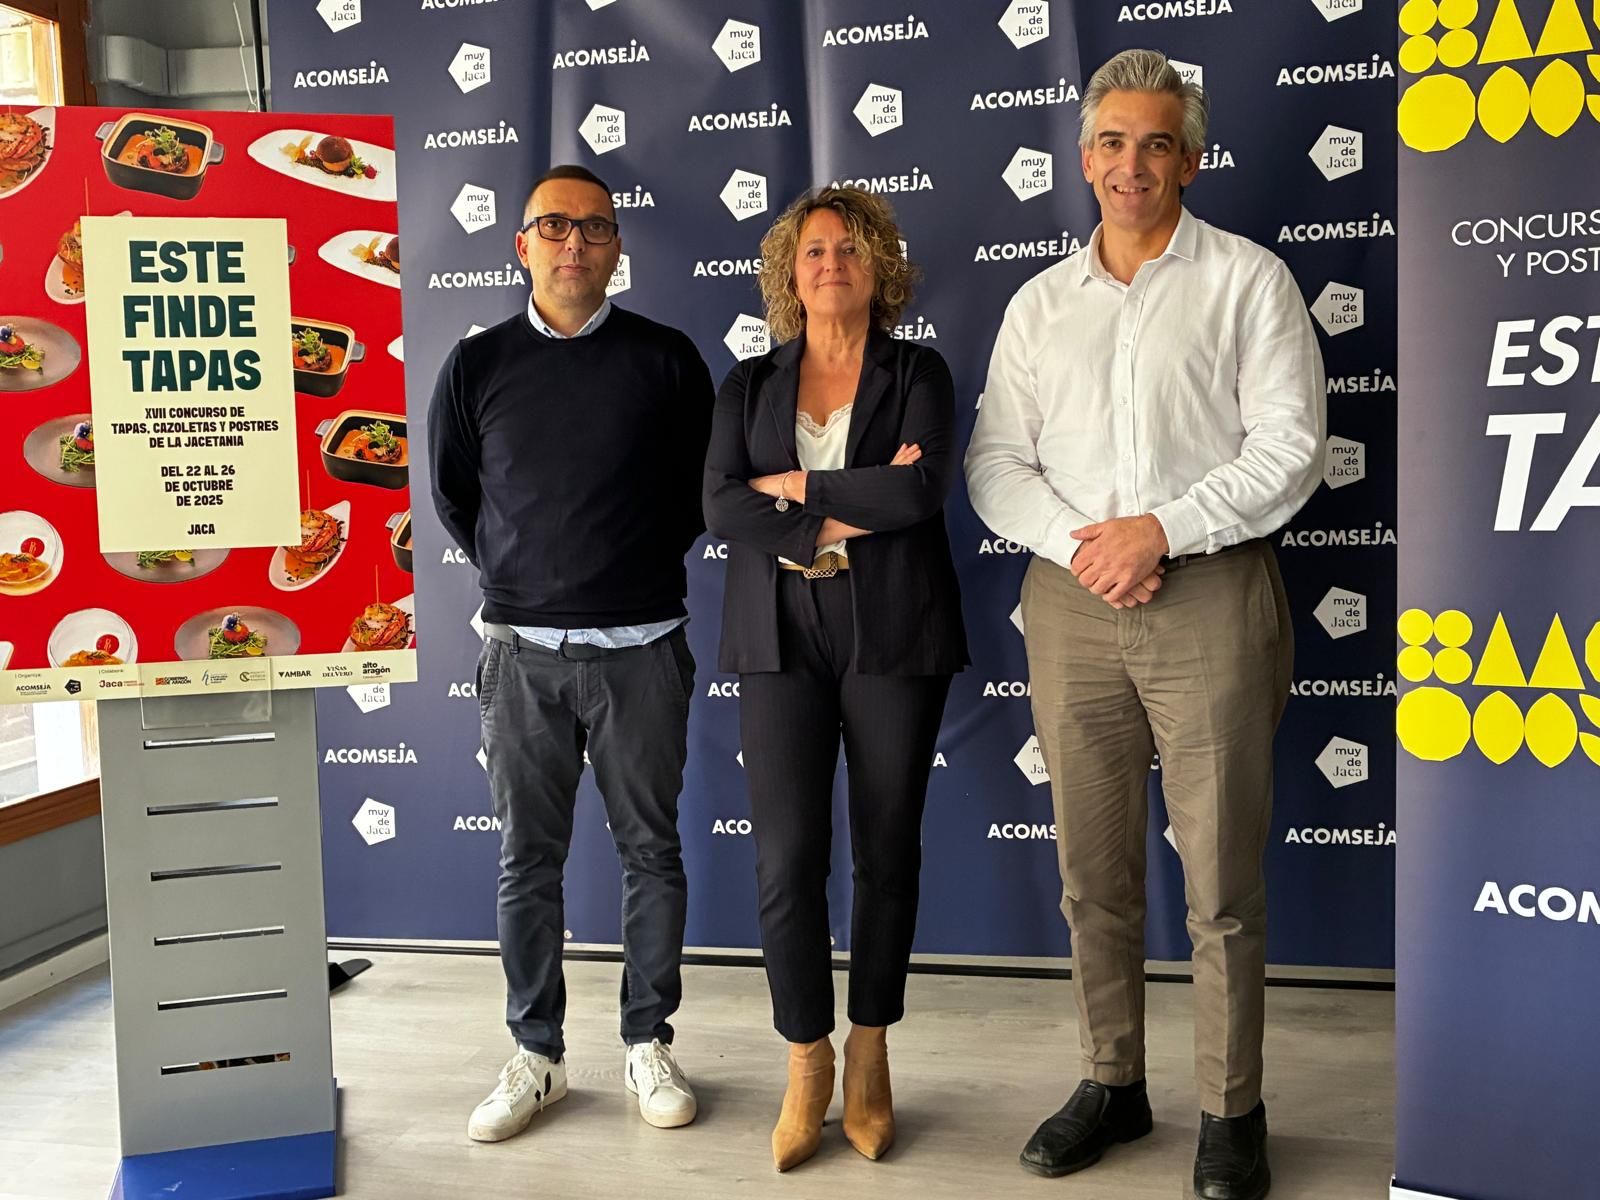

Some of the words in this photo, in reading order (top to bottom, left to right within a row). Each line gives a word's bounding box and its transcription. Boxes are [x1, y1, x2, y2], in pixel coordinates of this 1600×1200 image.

[1018, 5, 1042, 14] muy
[1118, 0, 1232, 21] ACOMSEJA
[332, 11, 356, 21] Jaca
[1029, 16, 1042, 24] de
[730, 30, 753, 39] muy
[823, 15, 928, 47] ACOMSEJA
[1016, 24, 1043, 36] Jaca
[741, 40, 754, 48] de
[465, 53, 484, 63] muy
[553, 40, 649, 69] ACOMSEJA
[728, 50, 754, 60] Jaca
[473, 62, 485, 70] de
[1276, 54, 1394, 85] ACOMSEJA
[294, 61, 389, 88] ACOMSEJA
[462, 71, 486, 82] Jaca
[1177, 70, 1196, 79] uy
[872, 94, 895, 103] muy
[971, 78, 1079, 110] ACOMSEJA
[883, 105, 896, 113] de
[597, 115, 619, 123] muy
[689, 103, 791, 131] ACOMSEJA
[870, 112, 897, 124] Jaca
[607, 125, 619, 133] de
[425, 121, 518, 149] ACOMSEJA
[595, 132, 620, 143] Jaca
[1330, 136, 1355, 145] muy
[1341, 147, 1356, 156] de
[1021, 158, 1046, 167] muy
[1327, 157, 1357, 169] Jaca
[1032, 169, 1046, 177] de
[738, 180, 760, 188] muy
[1019, 178, 1047, 189] Jaca
[748, 190, 761, 198] de
[477, 204, 489, 212] de
[736, 199, 762, 209] Jaca
[466, 211, 490, 222] Jaca
[1278, 213, 1395, 242] ACOMSEJA
[975, 231, 1080, 264] ACOMSEJA
[129, 240, 246, 283] ESTE
[1497, 252, 1517, 277] Y
[429, 263, 526, 288] ACOMSEJA
[1331, 293, 1357, 302] muy
[1342, 303, 1357, 312] de
[123, 295, 257, 338] FINDE
[1328, 312, 1357, 324] Jaca
[742, 325, 765, 335] muy
[752, 334, 765, 343] de
[740, 343, 766, 353] Jaca
[1486, 314, 1600, 387] ES
[122, 350, 262, 392] TAPAS
[145, 407, 166, 419] XVII
[169, 407, 227, 418] CONCURSO
[230, 406, 245, 417] DE
[111, 423, 150, 434] TAPAS,
[153, 422, 216, 433] CAZOLETAS
[219, 422, 226, 432] Y
[229, 420, 279, 432] POSTRES
[149, 437, 164, 448] DE
[167, 437, 181, 447] LA
[184, 436, 244, 447] JACETANIA
[1332, 447, 1358, 455] muy
[1344, 457, 1358, 465] de
[161, 466, 183, 477] DEL
[186, 465, 201, 476] 22
[204, 465, 218, 476] AL
[221, 465, 235, 475] 26
[1330, 466, 1359, 476] Jaca
[165, 481, 180, 492] DE
[183, 479, 233, 491] OCTUBRE
[176, 495, 191, 506] DE
[194, 494, 223, 506] 2025
[187, 524, 215, 535] JACA
[1281, 521, 1397, 547] ACOMSEJA
[1334, 598, 1359, 607] muy
[1345, 608, 1360, 617] de
[1331, 616, 1360, 627] Jaca
[285, 670, 312, 678] AMBAR
[363, 666, 391, 675] aragón
[362, 692, 385, 702] Jaca
[325, 743, 417, 763] ACOMSEJA
[1336, 748, 1361, 757] muy
[1347, 758, 1361, 766] de
[1333, 766, 1361, 776] Jaca
[367, 825, 390, 834] Jaca
[1285, 823, 1396, 845] ACOMSEJA
